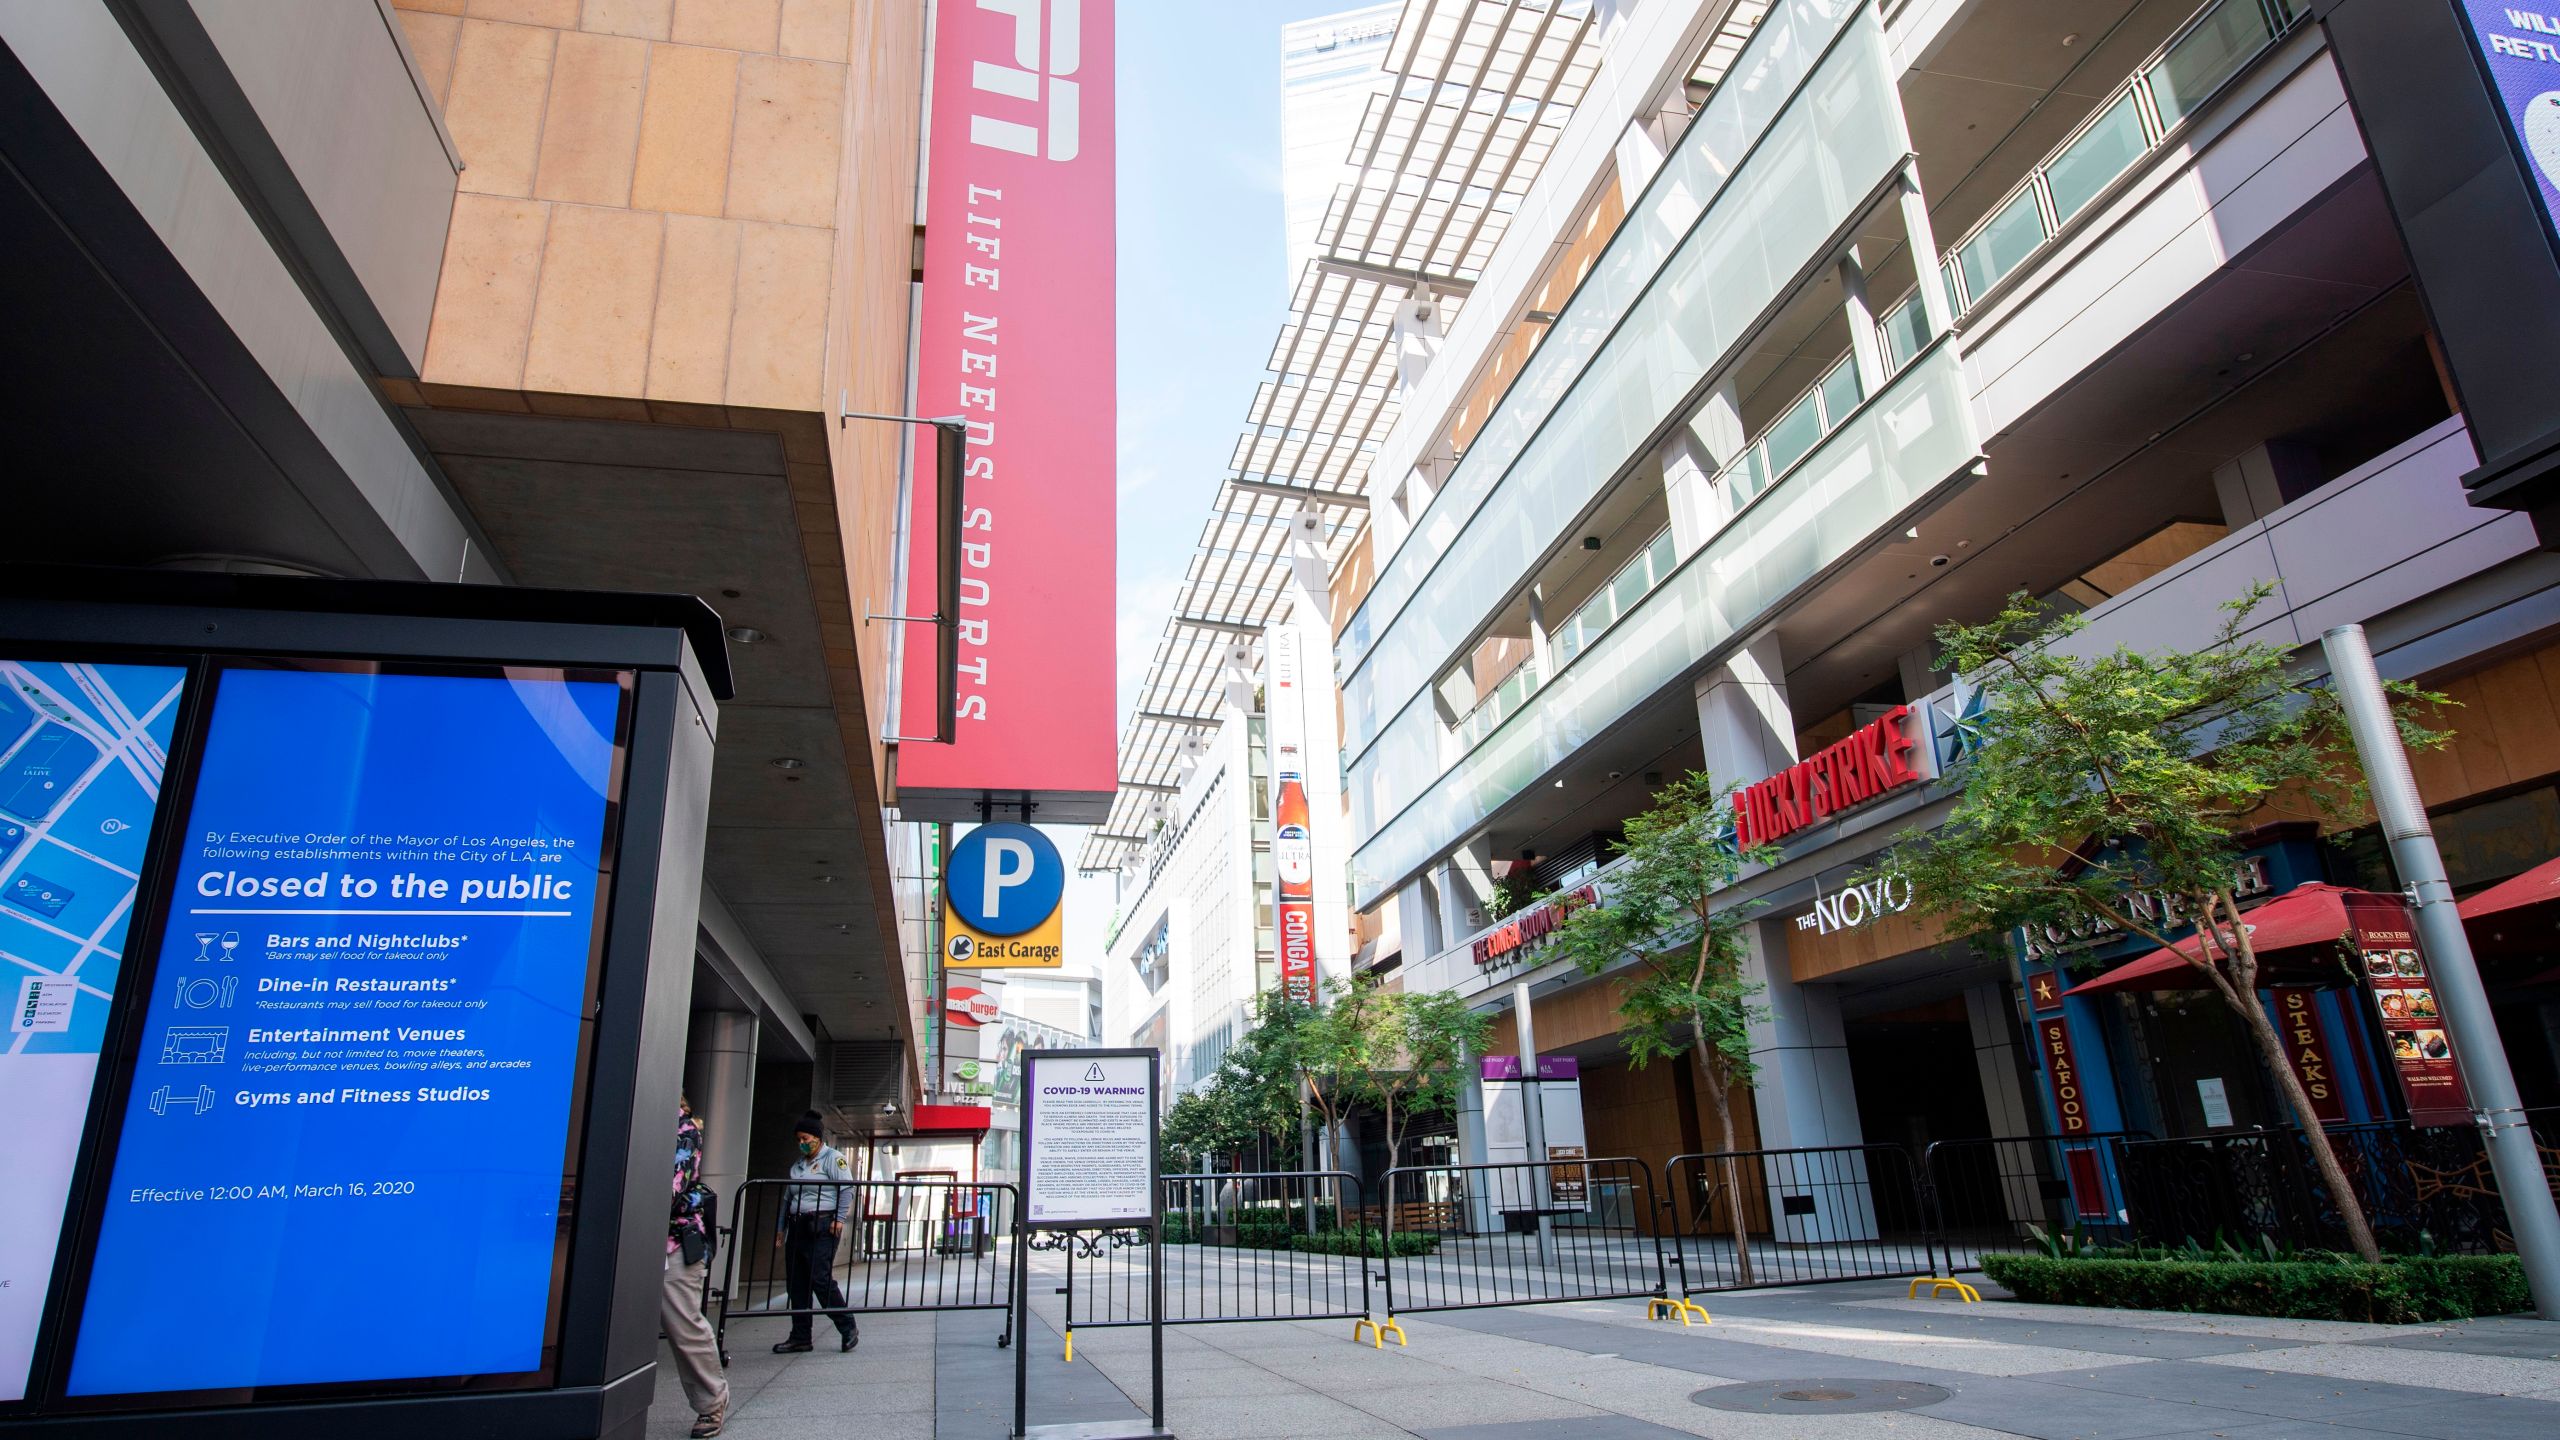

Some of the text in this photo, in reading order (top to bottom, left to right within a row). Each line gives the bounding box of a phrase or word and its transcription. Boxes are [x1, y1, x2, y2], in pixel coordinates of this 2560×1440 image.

[956, 183, 1001, 721] LIFE NEEDS SPORTS
[1732, 704, 1918, 853] LUCKY STRIKE
[206, 831, 575, 849] By Executive Order of the Mayor of Los Angeles, the
[202, 847, 562, 863] following establishments within the City of L.A. are
[197, 870, 573, 904] Closed to the public
[983, 837, 1035, 918] P
[1796, 872, 1913, 935] THE NOVO
[266, 934, 310, 948] Bars
[314, 934, 351, 948] and
[1285, 910, 1310, 971] CONGA
[1471, 938, 1489, 965] THE
[1487, 922, 1521, 957] CONGA
[1518, 907, 1554, 942] ROOM
[2394, 931, 2410, 939] FISH
[294, 952, 319, 961] may
[319, 951, 339, 960] sell
[339, 951, 365, 960] food
[366, 951, 383, 960] for
[384, 951, 424, 960] takeout
[426, 951, 449, 961] only
[977, 942, 1059, 963] East Garage
[258, 977, 329, 992] Dine-in
[326, 1001, 350, 1010] may
[352, 1000, 373, 1009] sell
[373, 1000, 401, 1009] food
[402, 1000, 419, 1009] for
[420, 1000, 462, 1009] takeout
[464, 1000, 488, 1010] only
[248, 1027, 466, 1043] Entertainment Venues
[244, 1048, 486, 1061] Including, but not limited to, movie theaters,
[2286, 993, 2328, 1099] STEAKS
[241, 1059, 532, 1073] live-performance venues, bowling alleys, and arcades
[2049, 1027, 2083, 1130] SEAFOOD
[235, 1086, 490, 1107] Gyms and Fitness Studios
[1043, 1086, 1145, 1095] COVID-19 WARNING
[130, 1181, 415, 1202] Effective 12:00 AM, March 16, 2020
